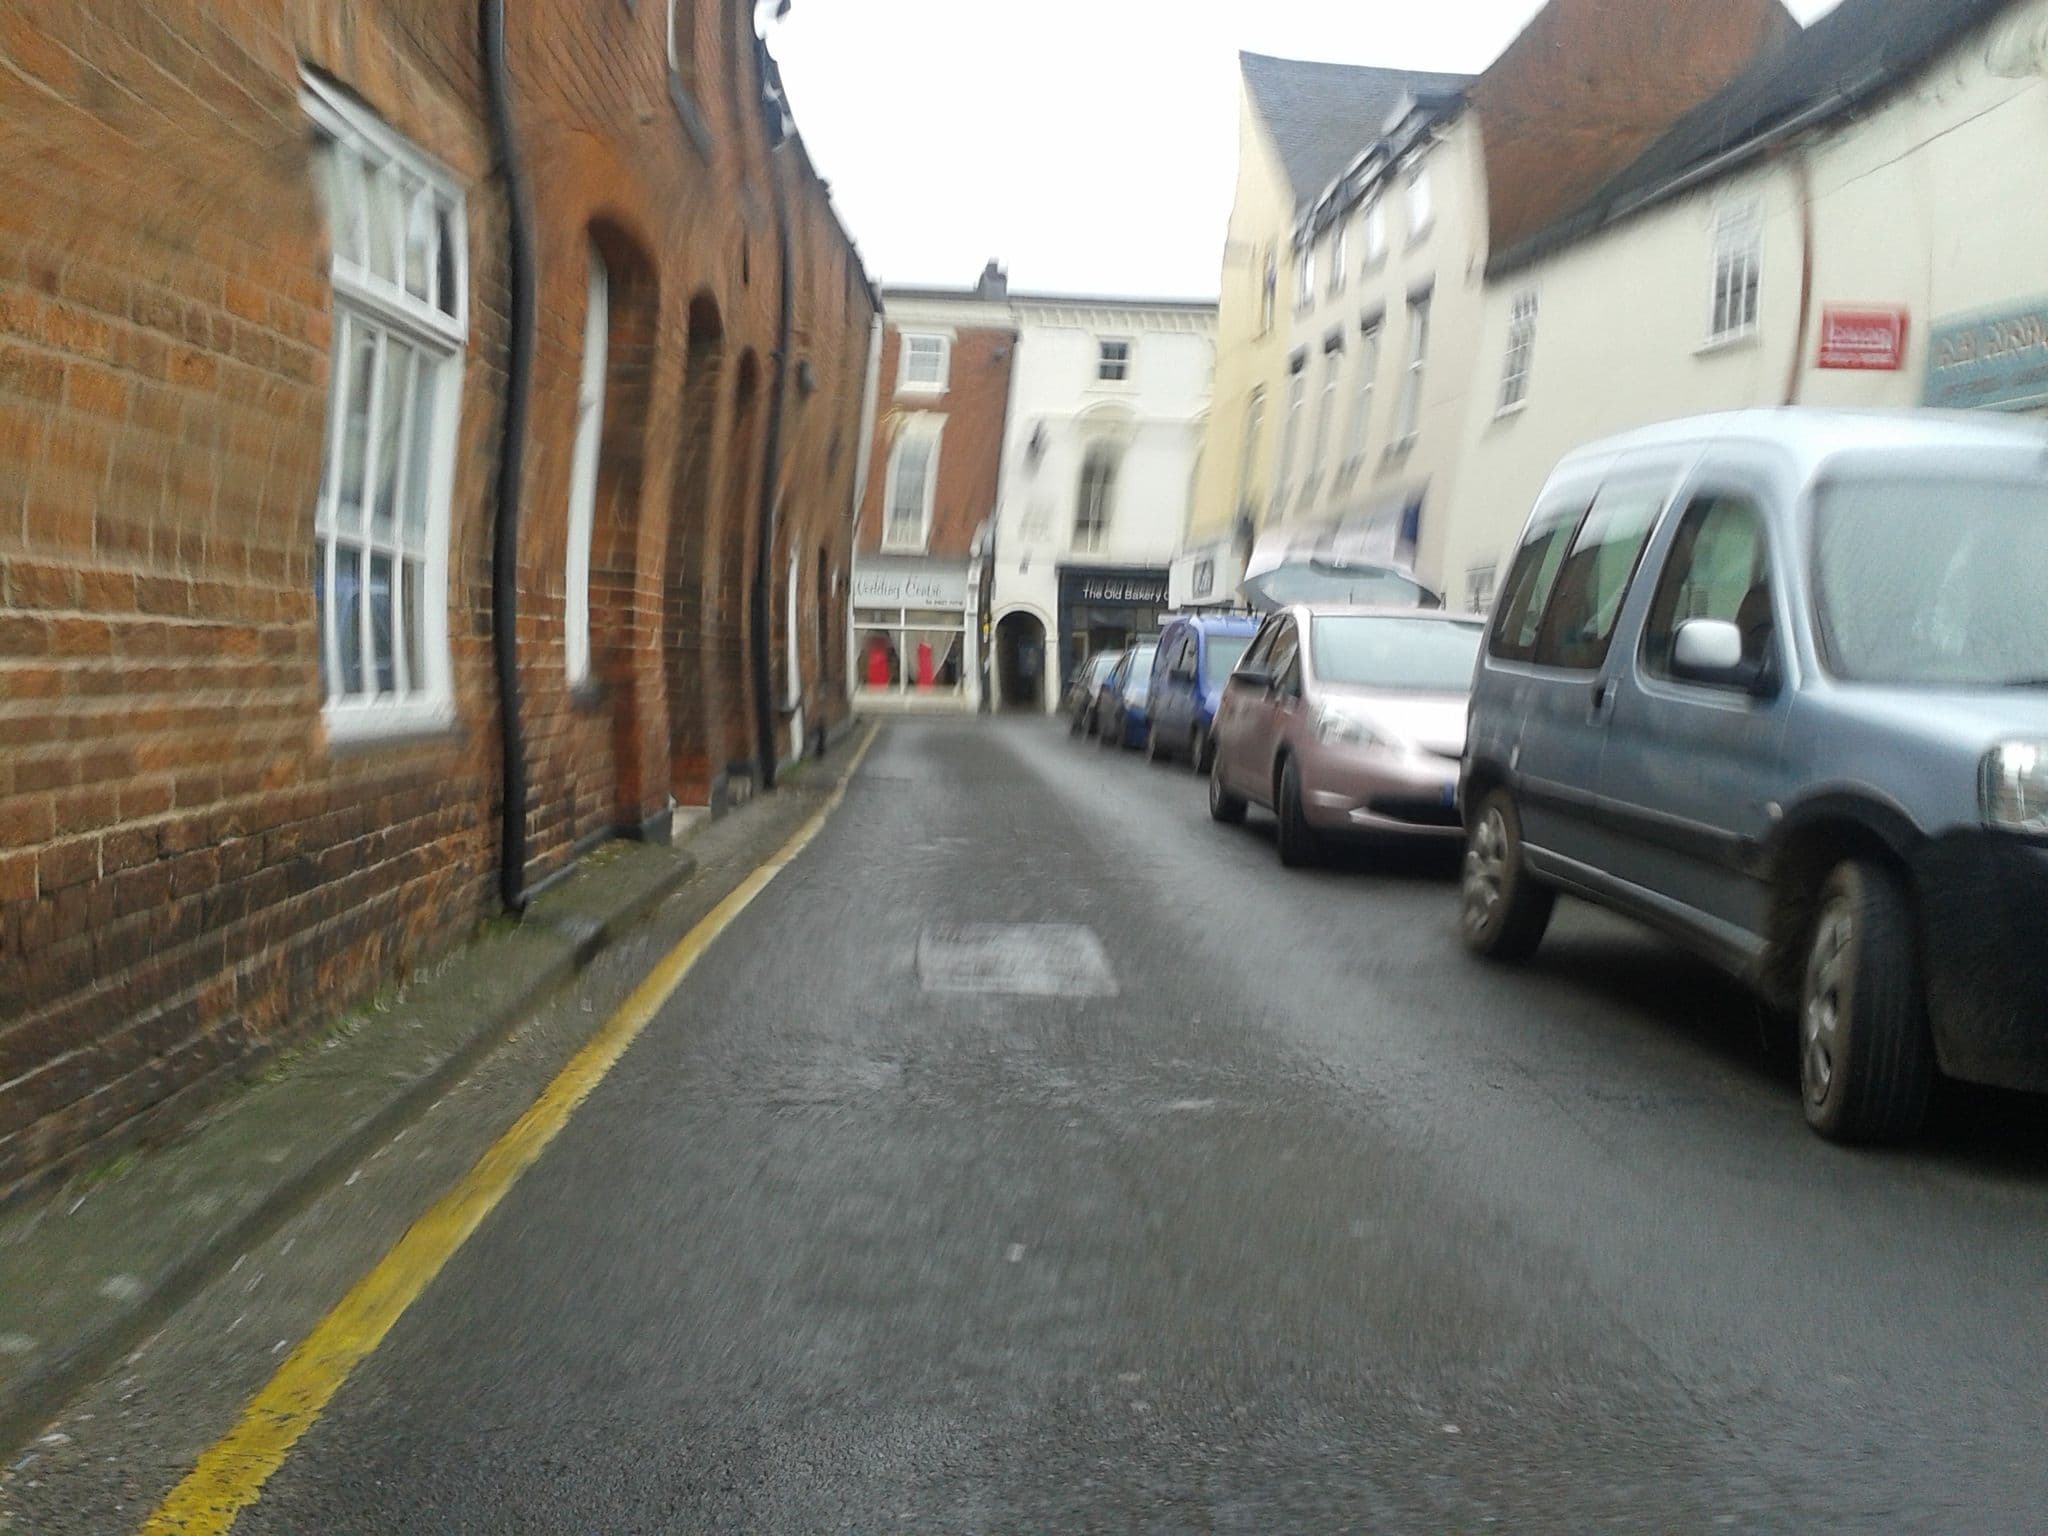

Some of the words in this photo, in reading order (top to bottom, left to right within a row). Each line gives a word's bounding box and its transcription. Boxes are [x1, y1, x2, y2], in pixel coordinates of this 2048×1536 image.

[1082, 586, 1102, 600] The
[1103, 586, 1122, 600] Old
[1124, 587, 1162, 604] Bakery
